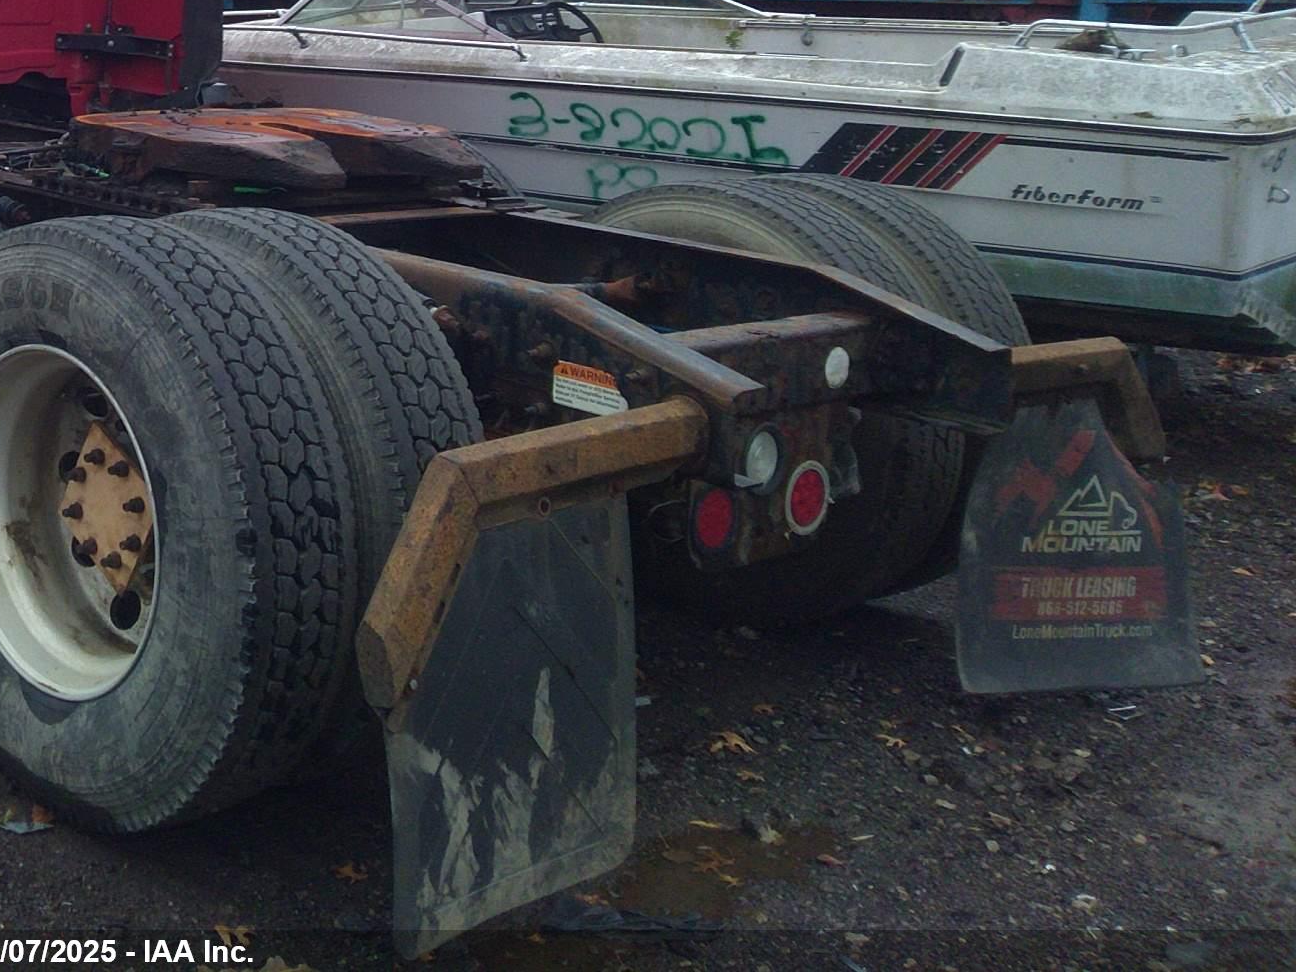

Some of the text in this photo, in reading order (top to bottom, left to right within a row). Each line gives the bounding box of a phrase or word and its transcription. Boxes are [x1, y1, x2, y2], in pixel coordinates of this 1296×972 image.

[1047, 519, 1109, 536] LONE
[1021, 536, 1142, 553] MOUNTAIN
[1075, 575, 1137, 598] LEASING
